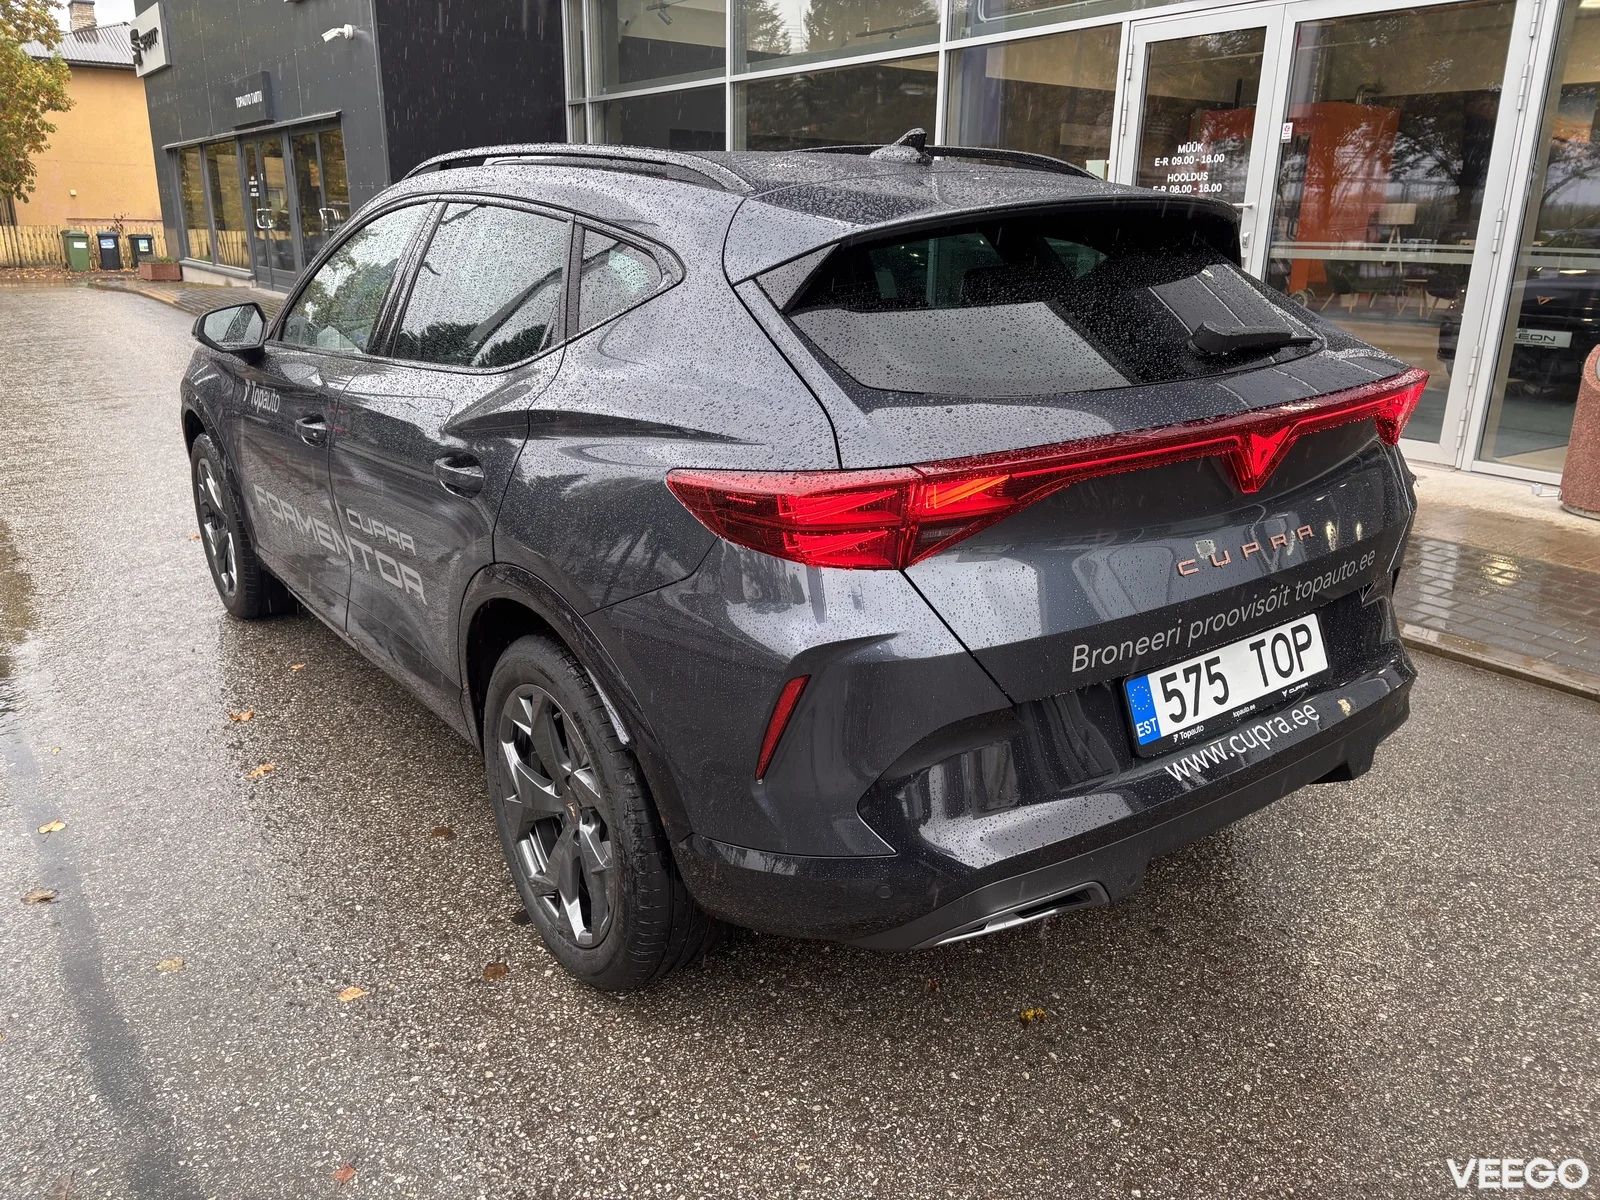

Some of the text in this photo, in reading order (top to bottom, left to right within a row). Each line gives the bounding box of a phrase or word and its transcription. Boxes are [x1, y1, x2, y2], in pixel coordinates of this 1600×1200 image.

[1177, 141, 1204, 154] MÜÜK
[1154, 157, 1169, 167] E-R
[1171, 155, 1195, 166] 09.00
[1201, 153, 1225, 164] 18.00
[1167, 171, 1209, 183] HOOLDUS
[1169, 184, 1192, 194] 08.00
[1198, 183, 1222, 193] 18.00
[251, 380, 281, 414] Topauto
[346, 508, 416, 556] CUPRA
[253, 484, 428, 606] FORMENTOR
[1177, 524, 1315, 577] CUPRA
[1071, 549, 1376, 673] Broneeri proovisõit topauto.ee
[1160, 623, 1312, 724] 575 TOP
[1289, 682, 1309, 694] CUPRA
[1232, 703, 1256, 718] topauto.ee
[1136, 717, 1157, 738] EST
[1179, 724, 1205, 740] Topauto
[1164, 703, 1320, 782] www.cupra.ee
